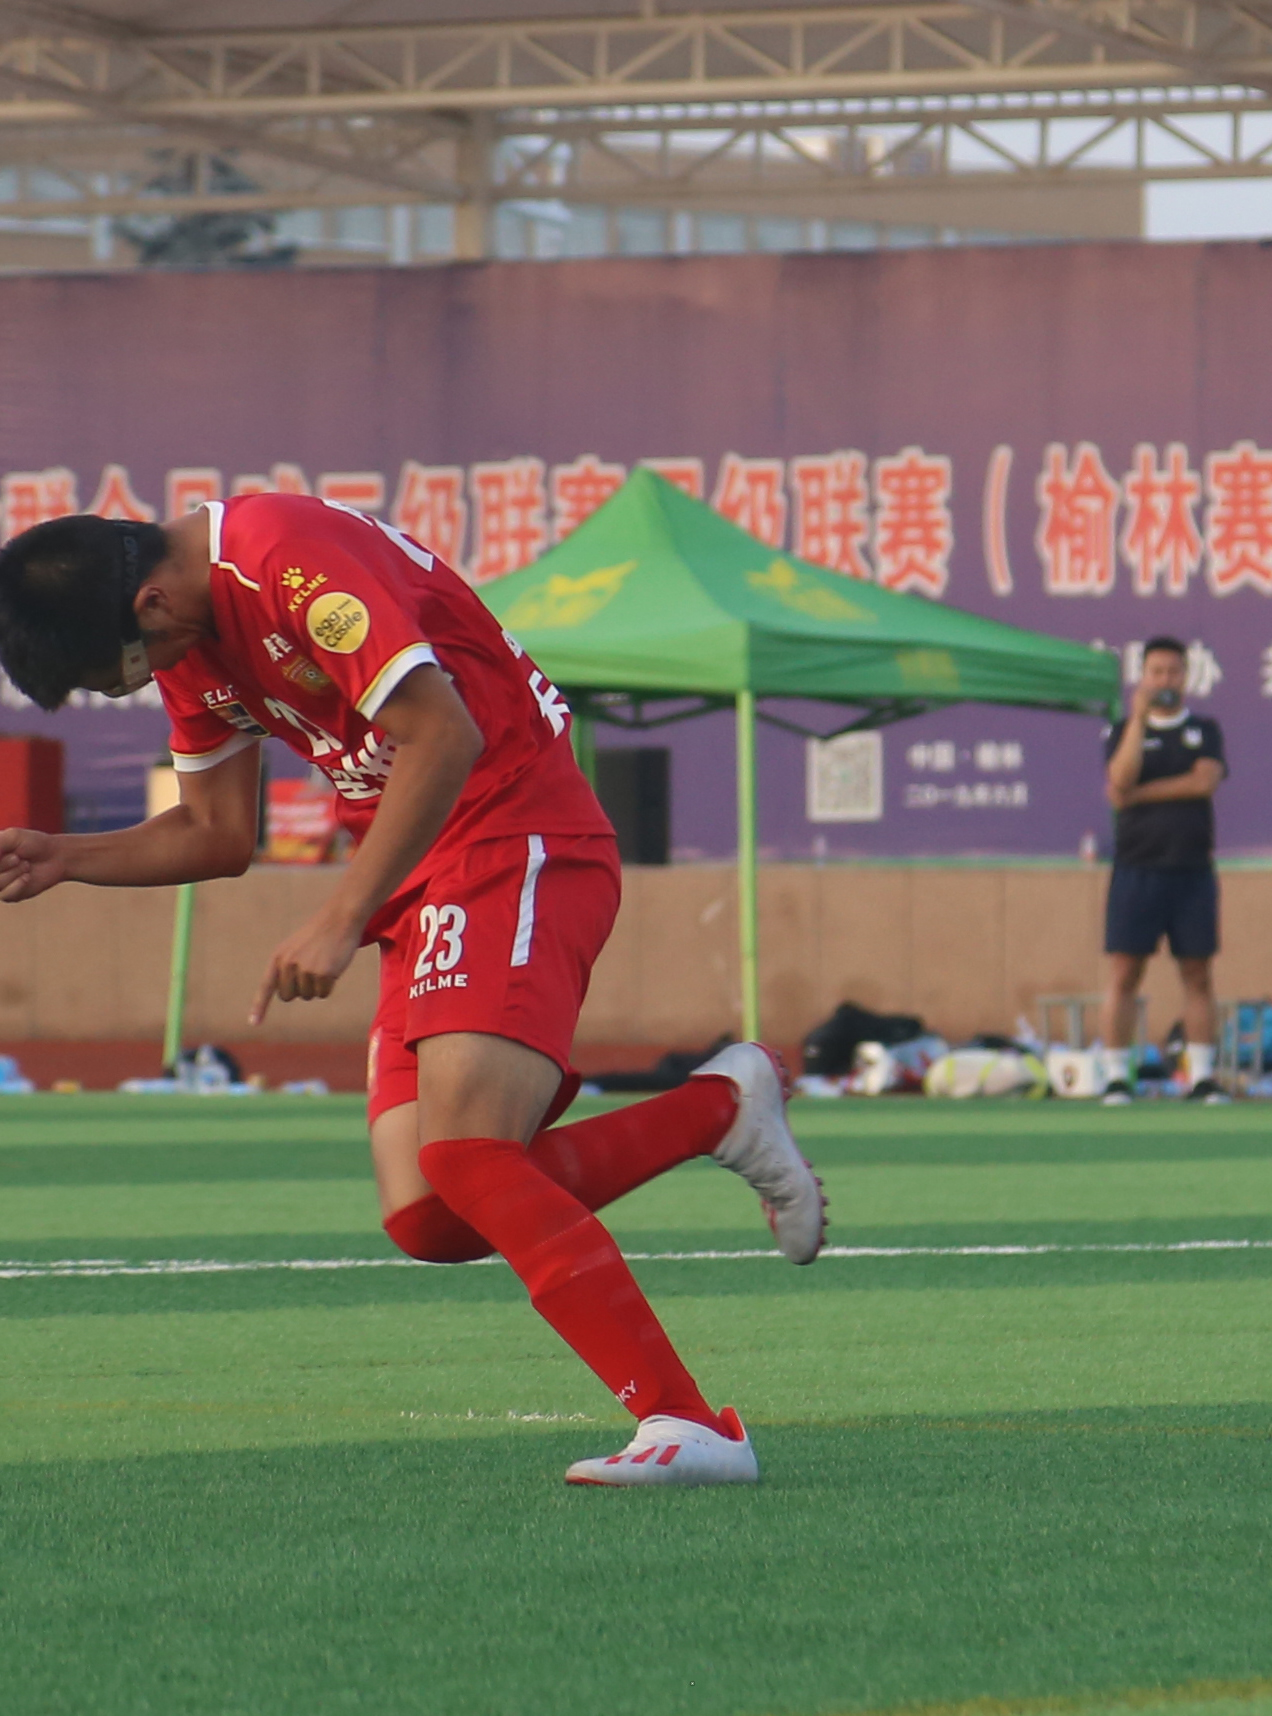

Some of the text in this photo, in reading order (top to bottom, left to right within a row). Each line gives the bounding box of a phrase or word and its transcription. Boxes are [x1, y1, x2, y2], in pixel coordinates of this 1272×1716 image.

[288, 573, 328, 613] KELME
[314, 610, 341, 637] egg
[414, 904, 467, 980] 23
[409, 974, 468, 999] KELME
